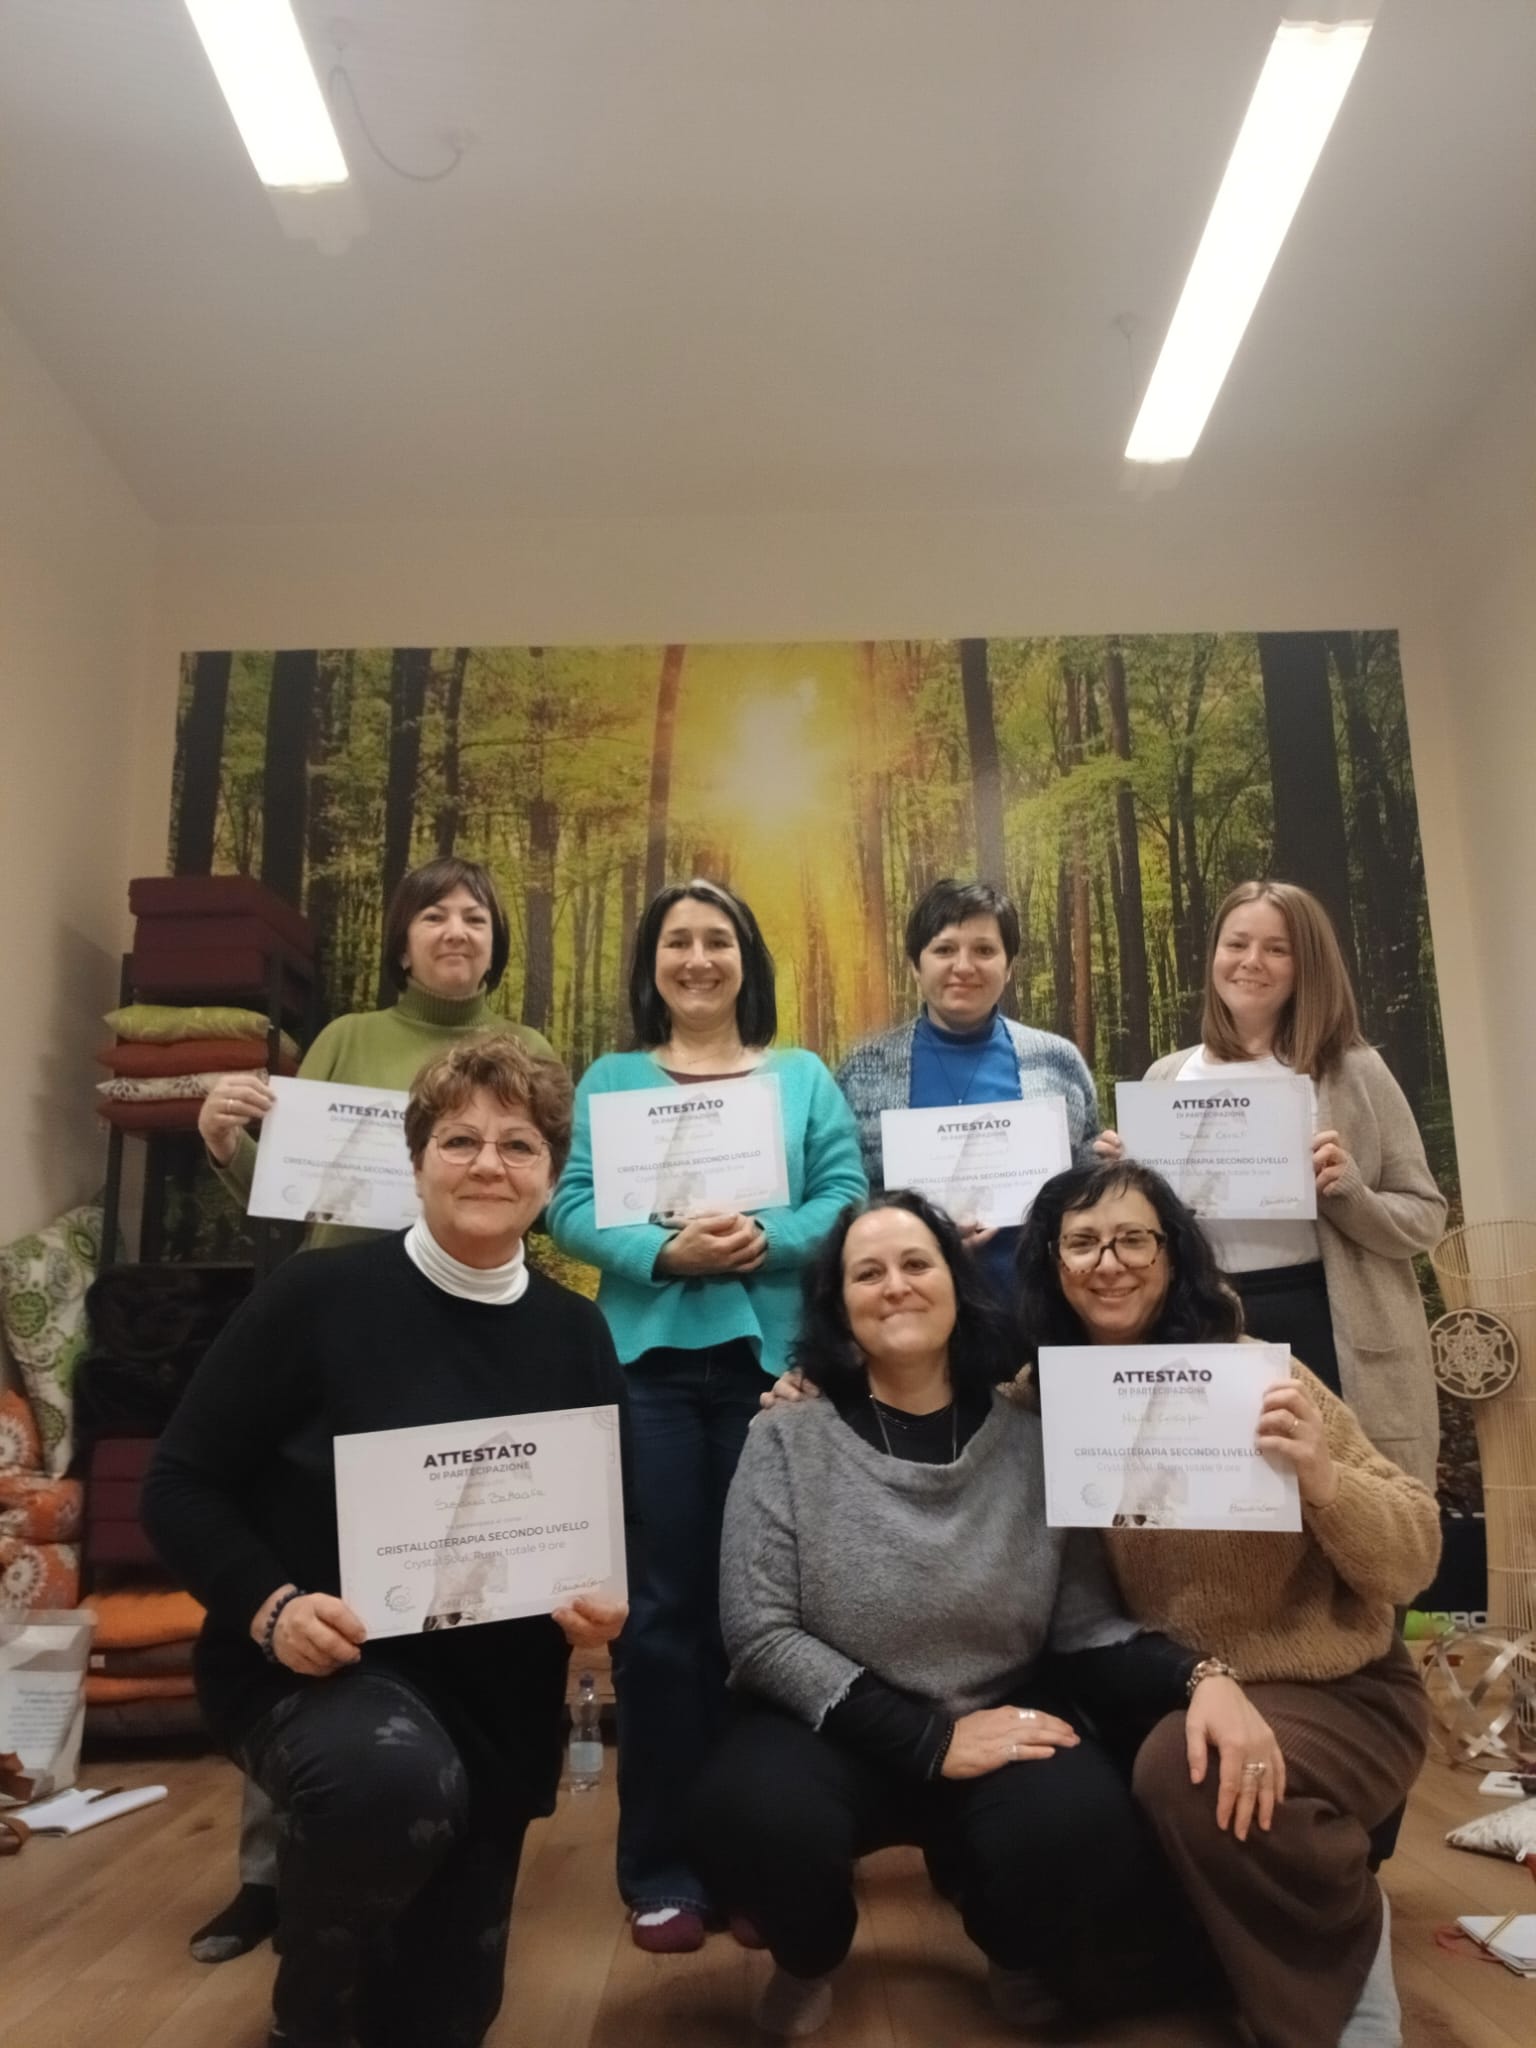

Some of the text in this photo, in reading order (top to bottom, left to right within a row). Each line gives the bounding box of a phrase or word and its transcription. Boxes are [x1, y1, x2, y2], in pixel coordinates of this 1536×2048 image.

[648, 1099, 724, 1117] ATTESTATO
[1172, 1097, 1250, 1109] ATTESTATO
[937, 1119, 1012, 1133] ATTESTATO
[1112, 1369, 1213, 1383] ATTESTATO
[423, 1442, 537, 1468] ATTESTATO
[1073, 1447, 1168, 1457] CRISTALLOTERAPIA
[1170, 1447, 1220, 1457] SECONDO
[429, 1461, 530, 1481] DI PARTECIPAZIONE
[377, 1534, 486, 1556] CRISTALLOTERAPIA
[488, 1526, 544, 1542] SECONDO
[546, 1520, 590, 1534] LIVELLO
[505, 1542, 537, 1556] totale
[539, 1541, 546, 1552] 9
[548, 1541, 567, 1551] ore
